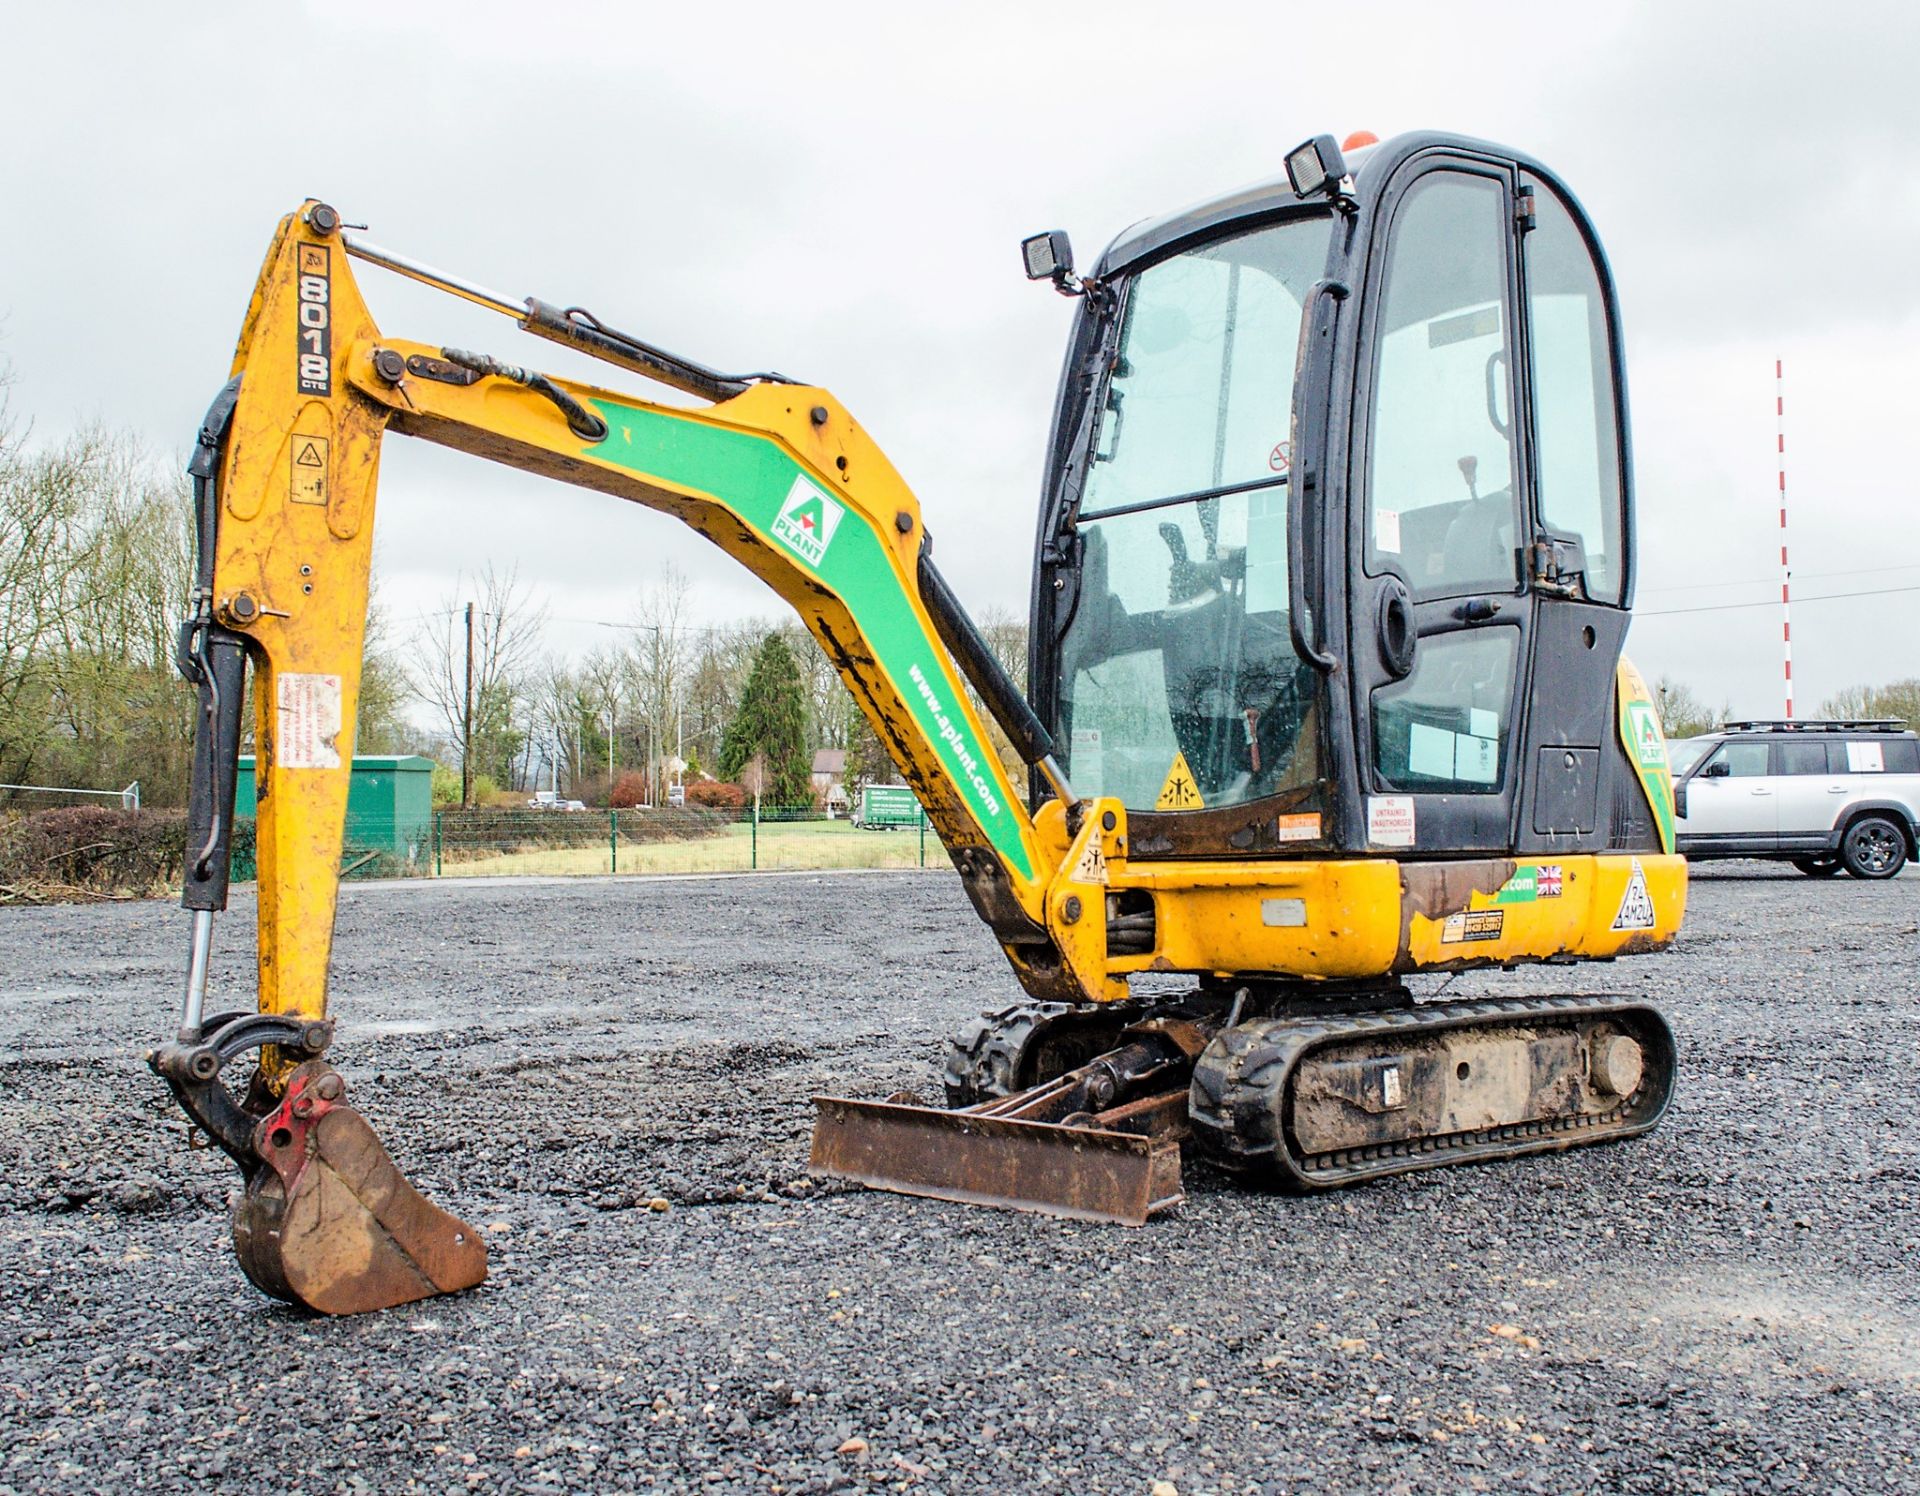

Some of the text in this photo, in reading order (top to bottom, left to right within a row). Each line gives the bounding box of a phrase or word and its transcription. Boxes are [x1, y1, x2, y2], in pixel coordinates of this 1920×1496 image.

[299, 275, 328, 381] 8018
[301, 379, 327, 390] CTS
[786, 494, 825, 543] A
[774, 519, 824, 562] PLANT
[908, 662, 1000, 818] www.aplant.com
[1641, 713, 1661, 743] A
[1371, 818, 1412, 827] UNAUTHORISED
[1376, 809, 1407, 817] UNTRAINED
